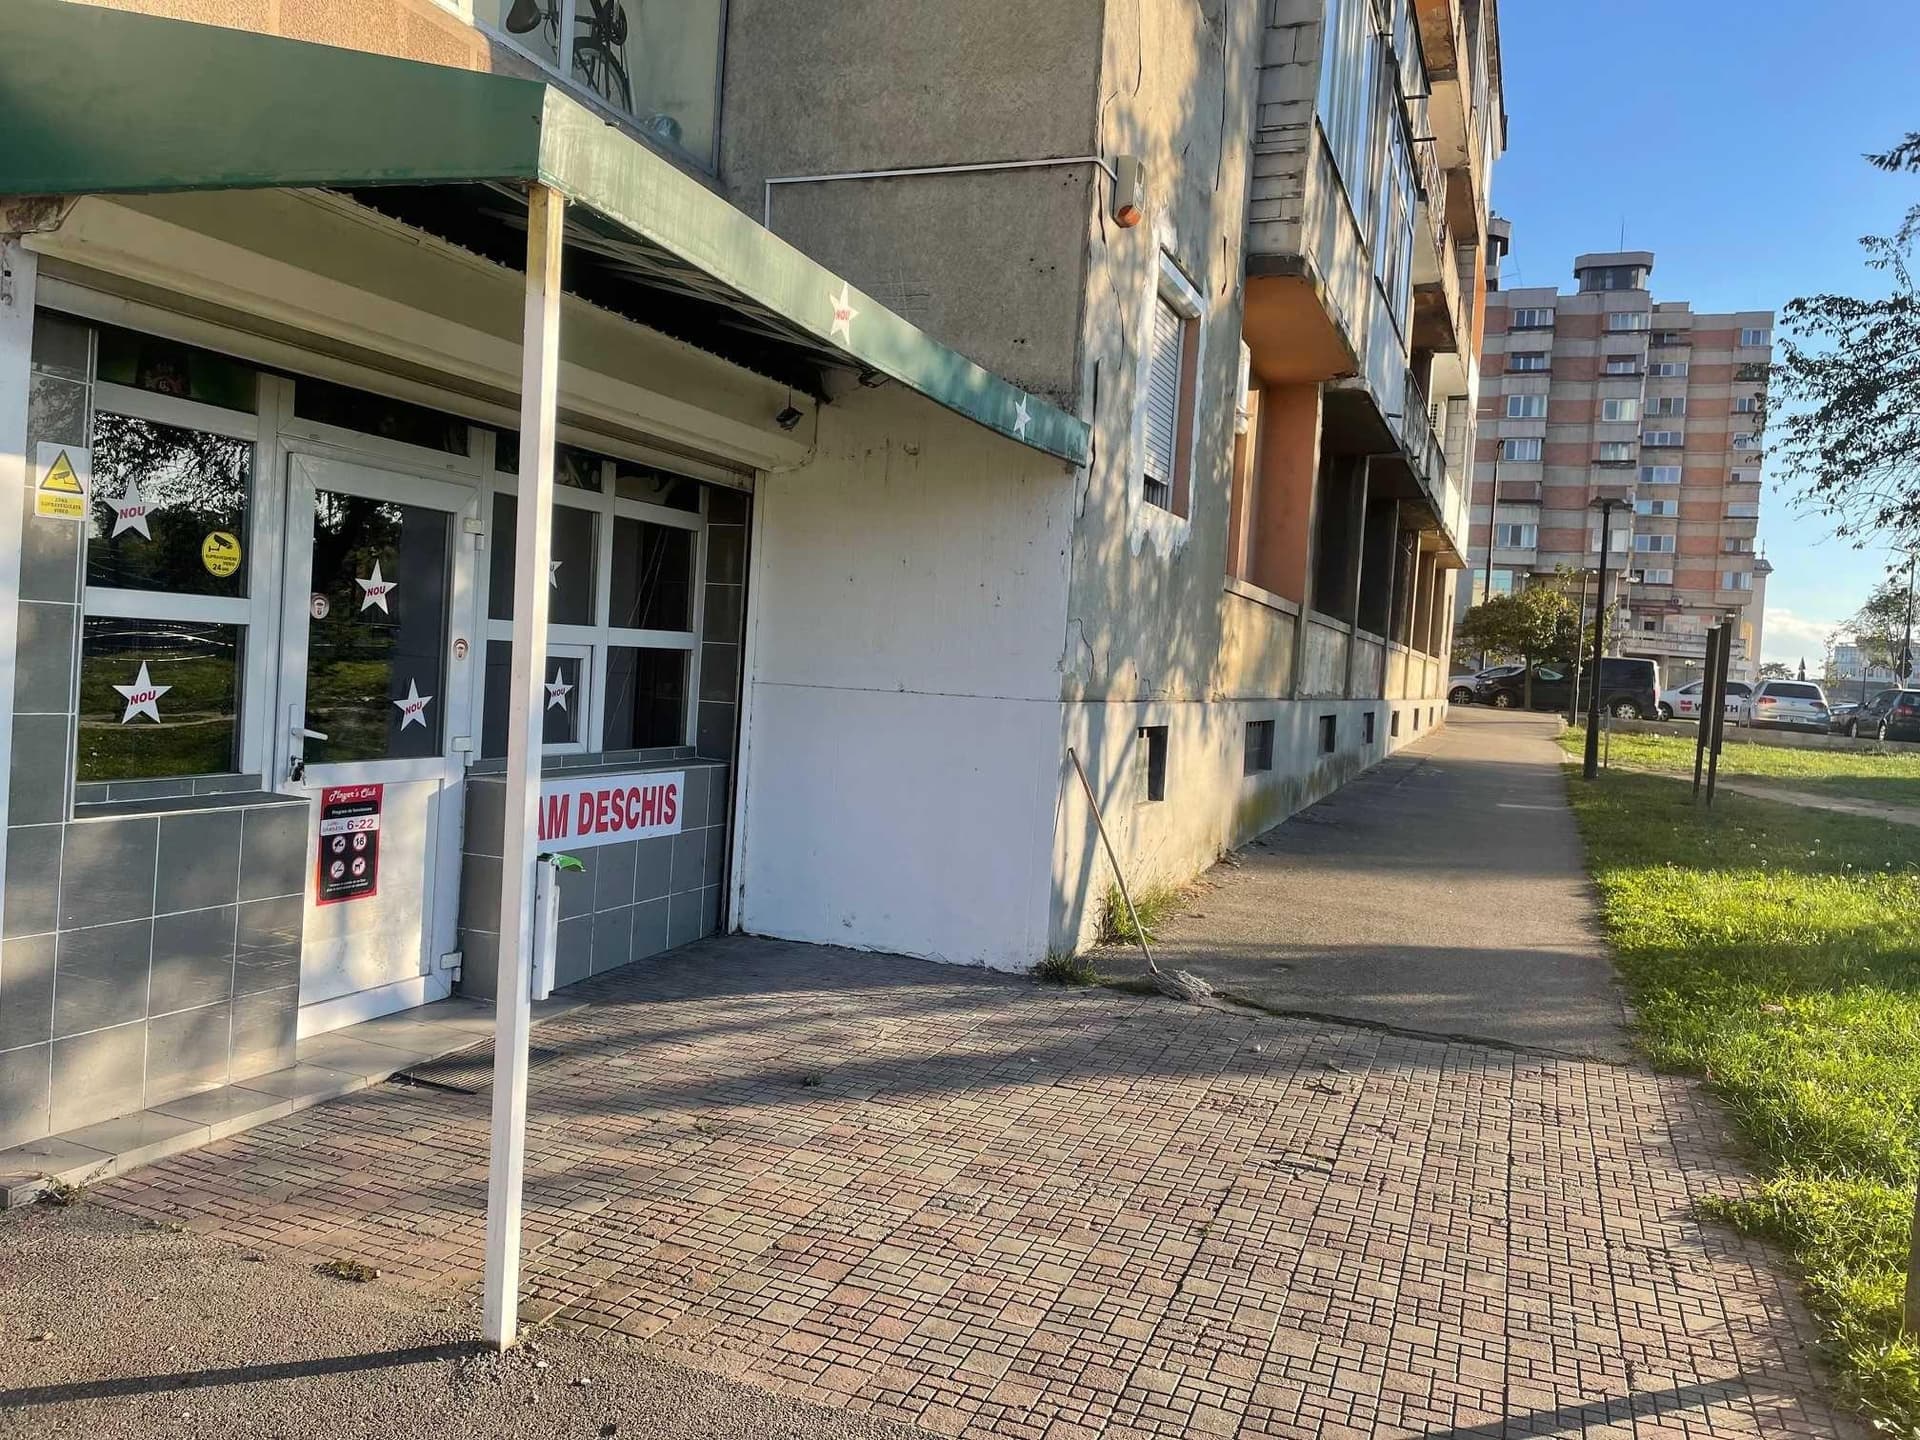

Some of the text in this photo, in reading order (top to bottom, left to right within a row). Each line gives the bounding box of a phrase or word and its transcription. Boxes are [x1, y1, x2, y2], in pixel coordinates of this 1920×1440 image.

[119, 506, 146, 520] NOU
[212, 563, 222, 571] 24
[367, 584, 386, 597] NOU
[130, 690, 156, 706] NOU
[551, 688, 566, 698] NOU
[405, 701, 423, 715] NOU
[1694, 704, 1738, 713] WTH
[361, 787, 376, 798] Club
[577, 784, 677, 836] DESCHIS
[346, 819, 374, 831] 6-22
